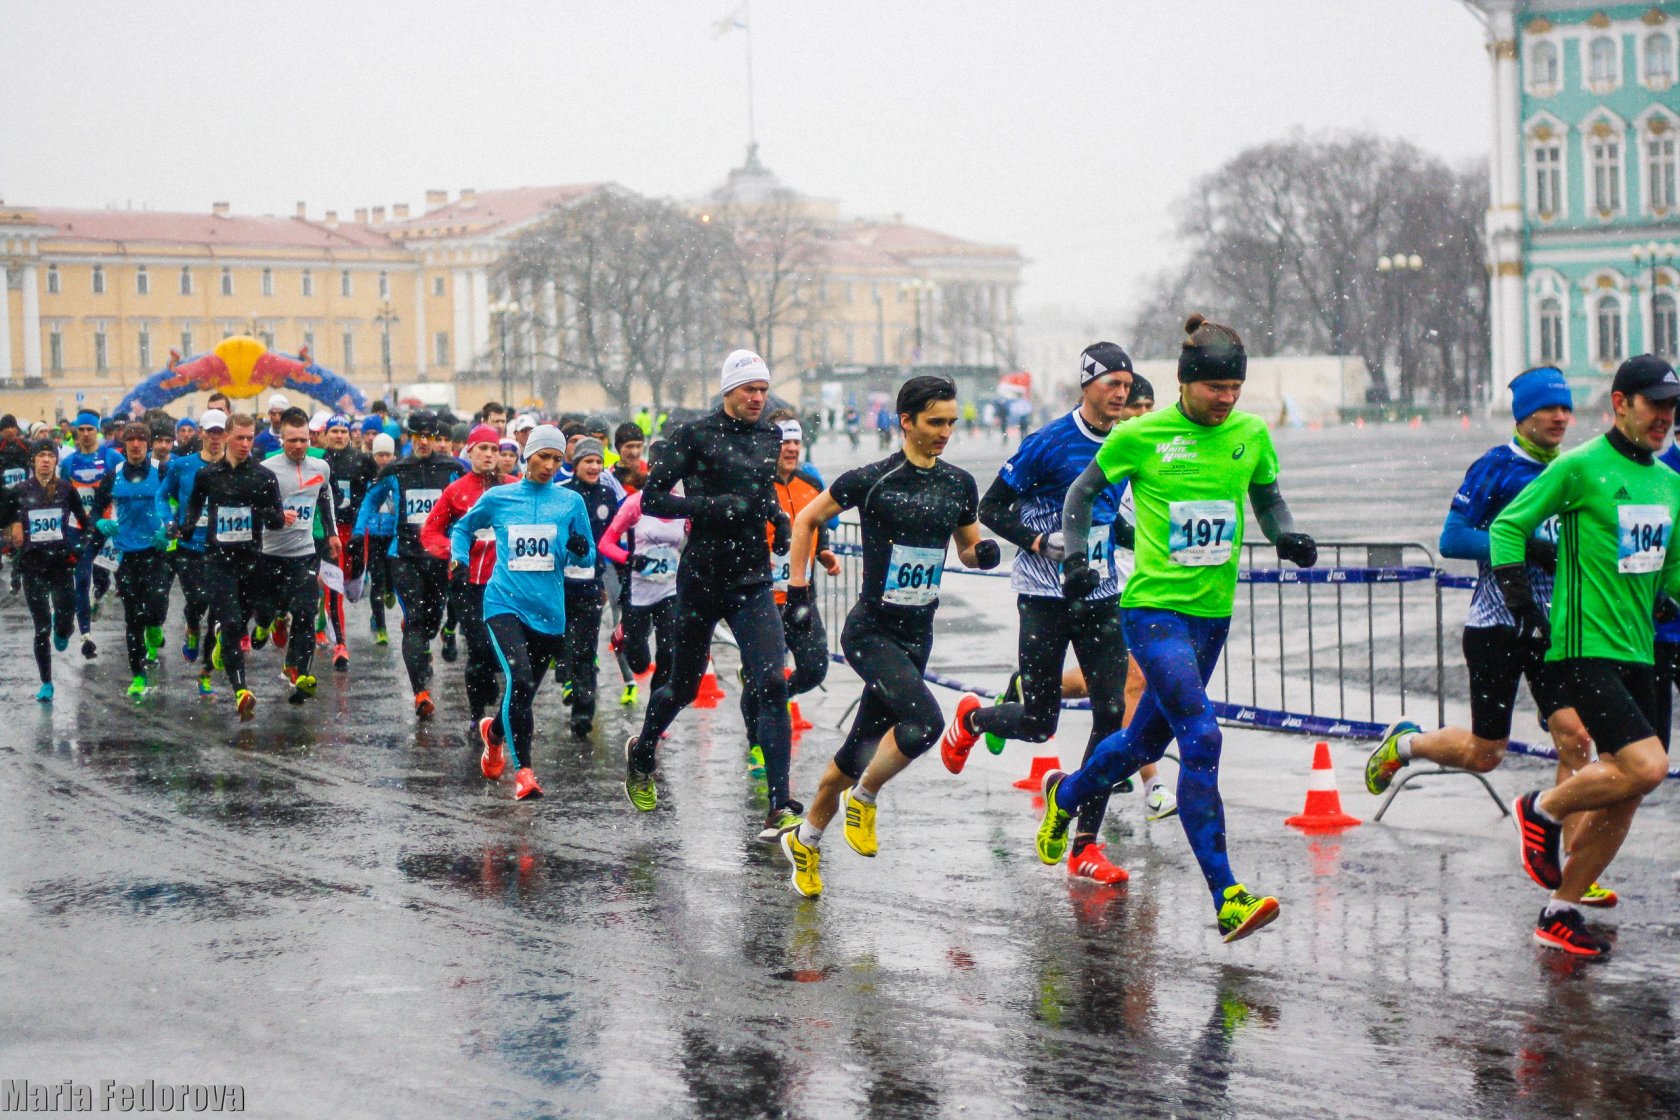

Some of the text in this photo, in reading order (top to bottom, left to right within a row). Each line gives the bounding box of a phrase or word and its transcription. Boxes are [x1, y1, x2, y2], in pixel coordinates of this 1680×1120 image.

[408, 499, 438, 513] 129
[34, 517, 57, 532] 530
[219, 516, 250, 532] 1121
[1182, 518, 1226, 547] 197
[515, 537, 549, 558] 830
[1631, 523, 1663, 552] 184
[897, 562, 936, 590] 661
